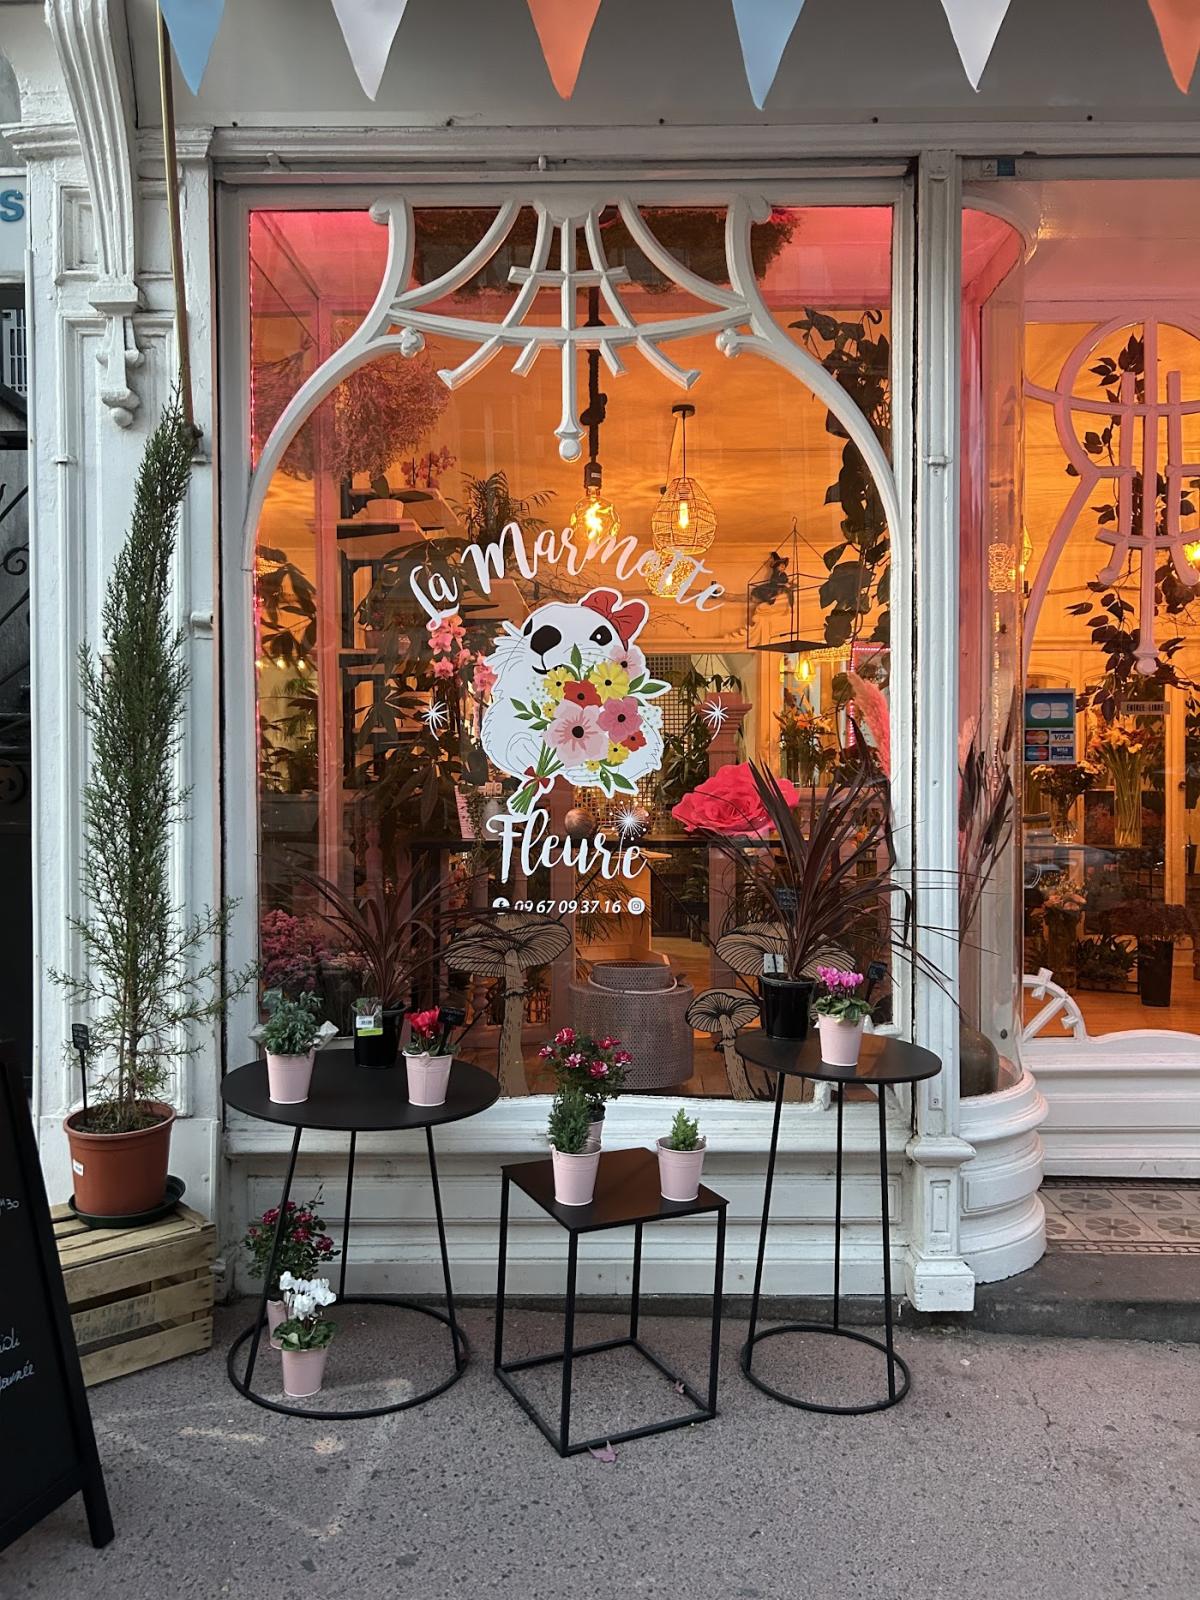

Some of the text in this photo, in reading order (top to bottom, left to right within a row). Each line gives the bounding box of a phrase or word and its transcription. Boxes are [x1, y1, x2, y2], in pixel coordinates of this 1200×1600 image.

[409, 522, 726, 632] La Marmotte
[485, 808, 648, 884] Fleurie
[514, 900, 622, 914] 09 67 09 37 16
